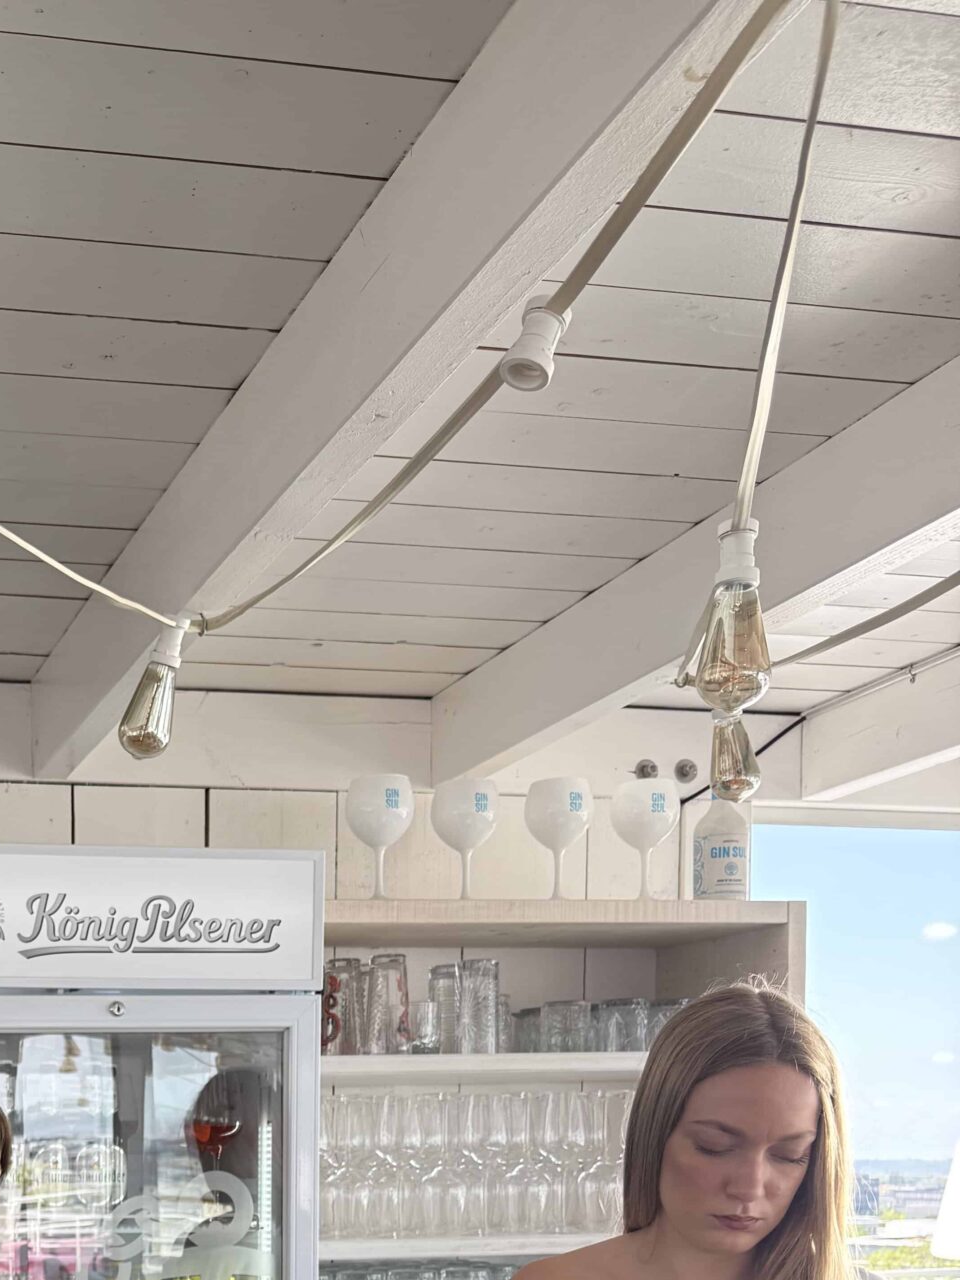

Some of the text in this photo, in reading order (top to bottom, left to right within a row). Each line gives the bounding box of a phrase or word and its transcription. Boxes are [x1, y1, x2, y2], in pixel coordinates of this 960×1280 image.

[385, 788, 400, 798] GIN
[475, 792, 488, 802] GIN
[569, 791, 583, 801] GIN
[651, 793, 665, 802] GIN
[710, 847, 730, 859] GIN
